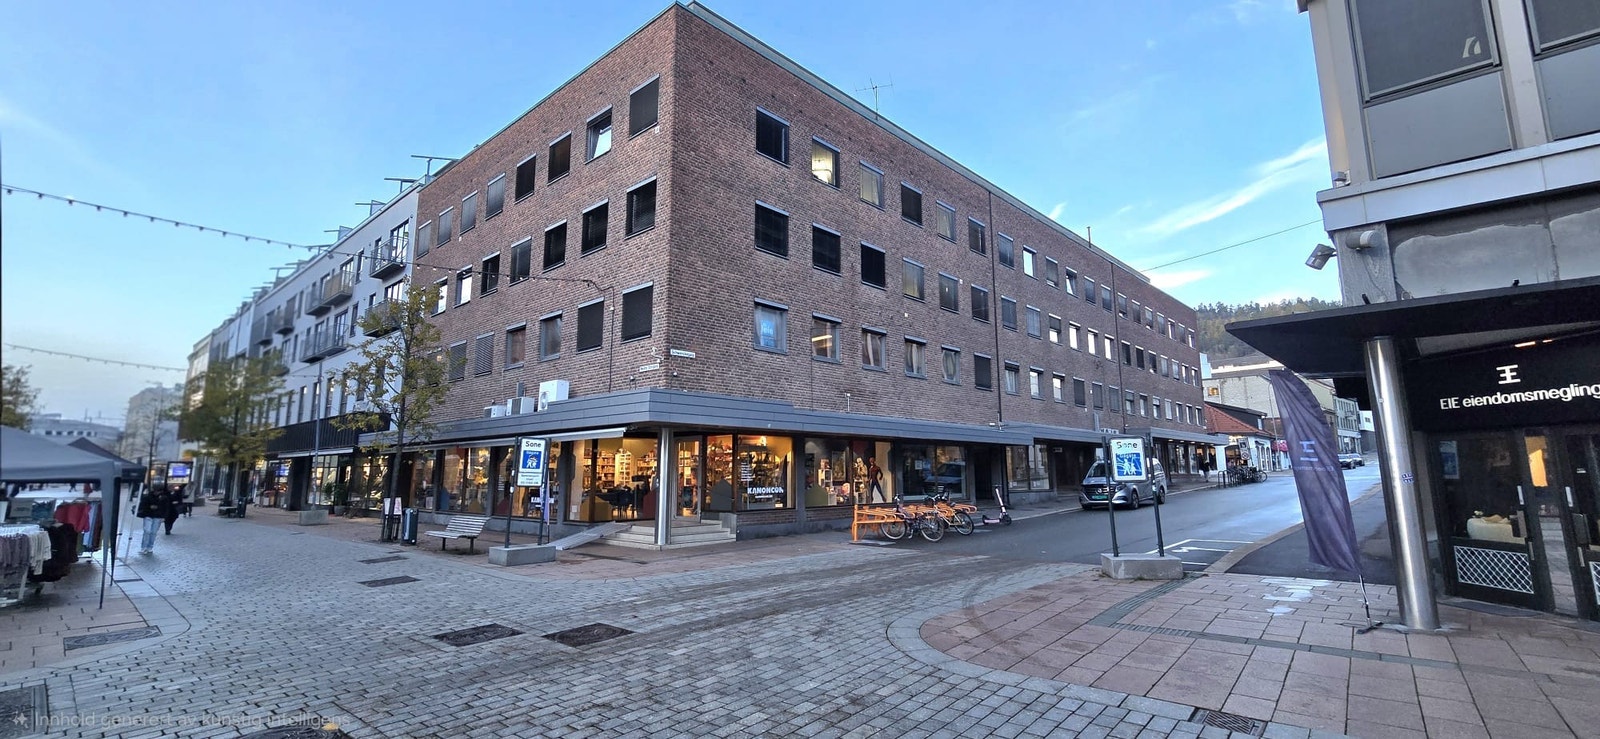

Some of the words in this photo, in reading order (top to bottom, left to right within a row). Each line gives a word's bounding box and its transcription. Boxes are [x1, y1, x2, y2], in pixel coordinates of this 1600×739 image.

[1439, 397, 1460, 410] EIE
[1462, 383, 1600, 408] eiendomsmegling
[525, 440, 542, 448] Sone
